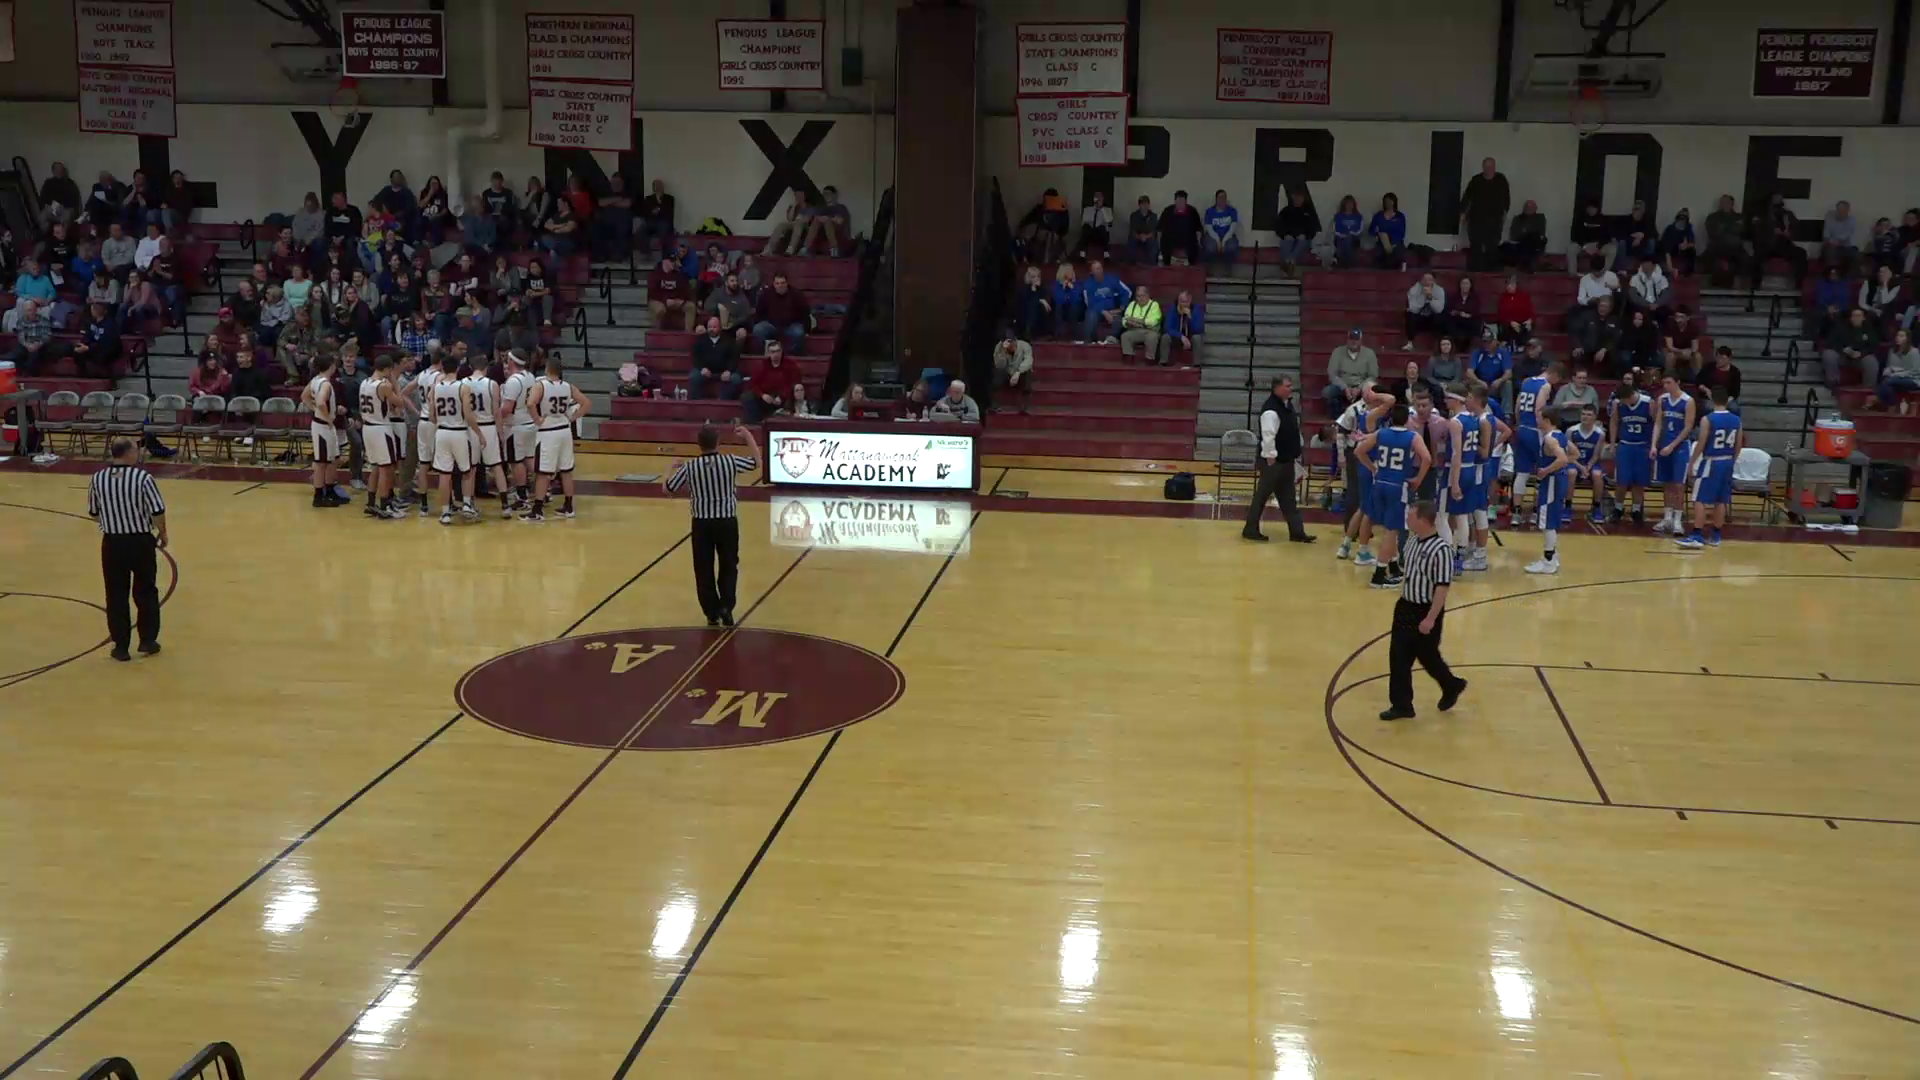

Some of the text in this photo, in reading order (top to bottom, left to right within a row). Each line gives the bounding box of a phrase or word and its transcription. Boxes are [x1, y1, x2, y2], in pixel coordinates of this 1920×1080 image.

[96, 23, 153, 33] CHAMPIONS
[353, 17, 432, 29] PENQUIS LEAGUE
[354, 32, 433, 44] CHAMPIONS
[724, 28, 816, 39] PENQUIS LEAGUE
[1019, 32, 1124, 43] GIRLS CROSS COUNTRY
[570, 35, 630, 45] CHAMPIONS
[347, 47, 440, 58] BOYS CROSS COUNTRY
[556, 49, 585, 59] CROSS
[588, 50, 631, 60] COUNTRY
[739, 44, 801, 54] CHAMPIONS
[1025, 47, 1119, 58] STATE CHAMPIONS
[1759, 50, 1805, 62] LEAGUE
[720, 60, 820, 71] GIRLS CROSS COUNTRY
[1046, 62, 1097, 72] CLASS C
[1775, 67, 1853, 77] WRESTLING
[558, 89, 585, 99] CROSS
[587, 91, 631, 102] COUNTRY
[565, 102, 596, 111] STATE
[1057, 99, 1087, 109] GIRLS
[552, 112, 609, 123] RUNNER UP
[1027, 111, 1118, 121] CROSS COUNTRY
[558, 124, 604, 134] CLASS C
[1032, 126, 1113, 137] PVC CLASS C
[1037, 139, 1108, 151] RUNNER UP
[436, 396, 457, 416] 23
[549, 396, 569, 414] 35
[1519, 391, 1536, 413] 22
[1627, 423, 1643, 434] 33
[1713, 429, 1738, 450] 24
[1377, 444, 1405, 471] 32
[822, 463, 917, 482] ACADEMY
